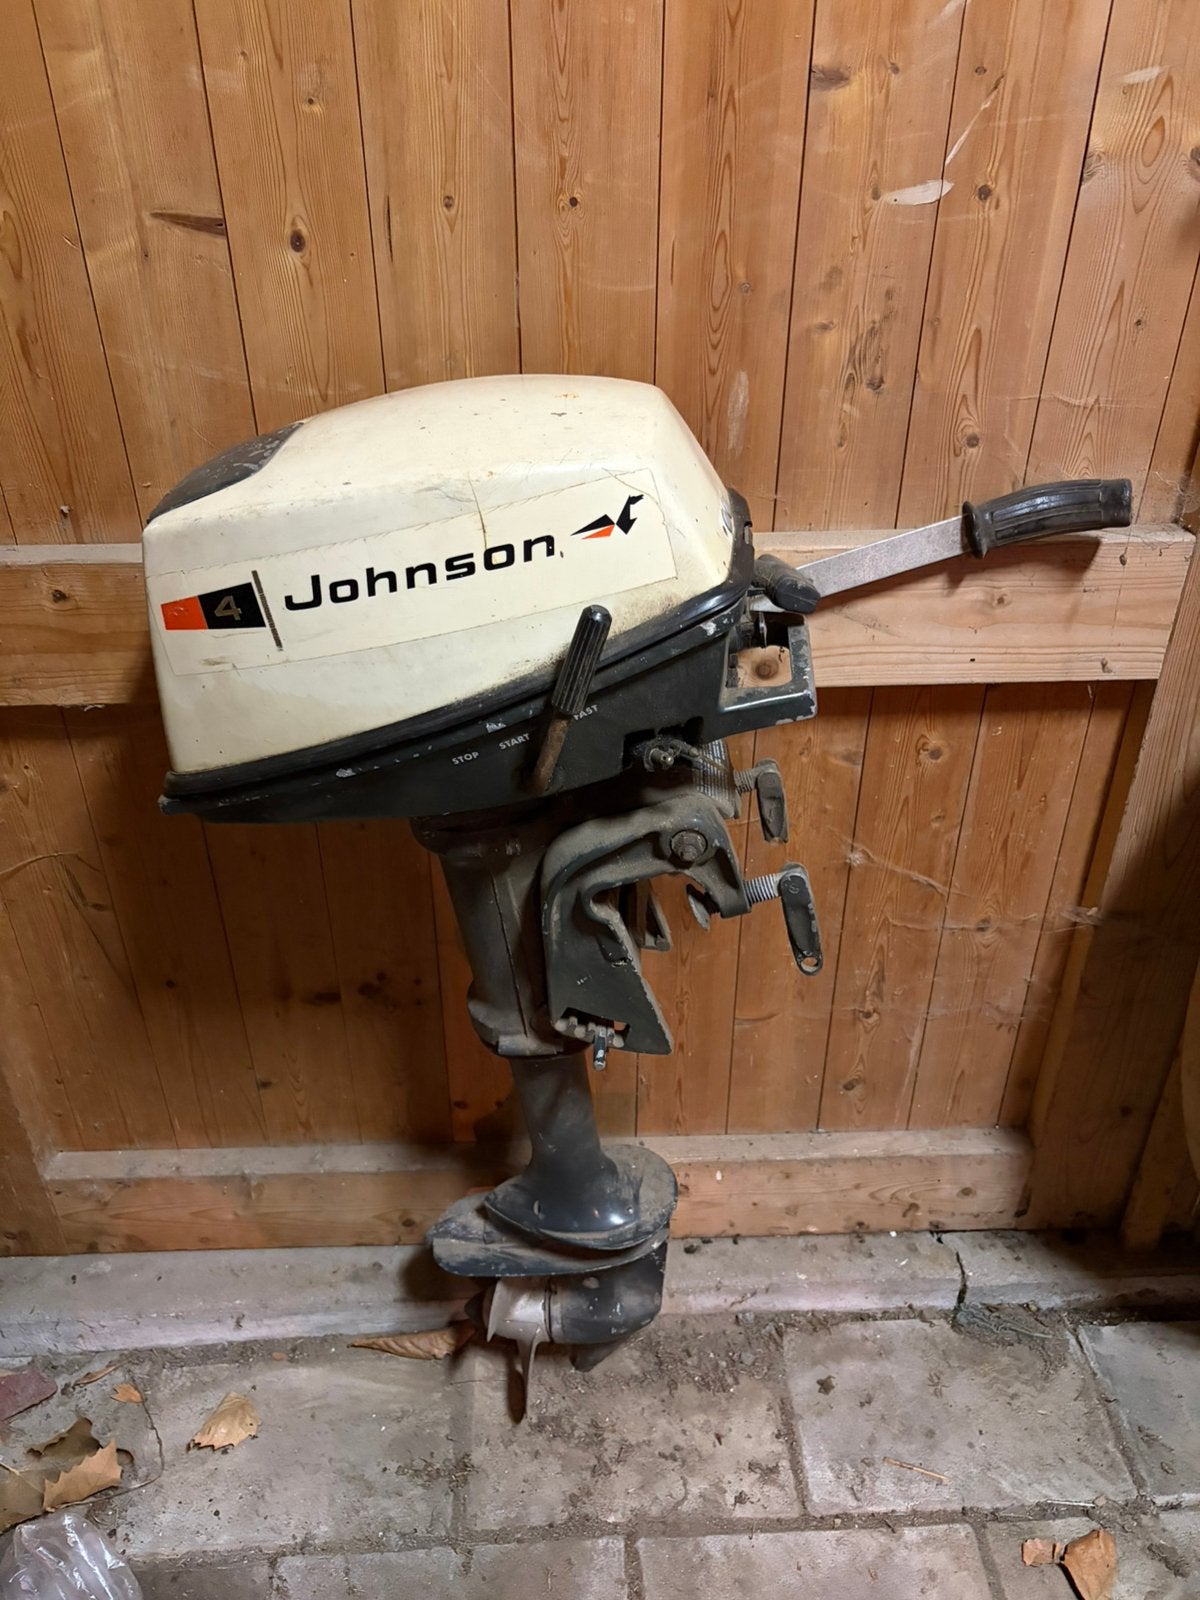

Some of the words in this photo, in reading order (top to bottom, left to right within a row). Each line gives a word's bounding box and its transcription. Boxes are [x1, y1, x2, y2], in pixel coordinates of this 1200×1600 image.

[284, 533, 555, 611] Johnson
[214, 595, 242, 621] 4
[451, 751, 480, 765] STOP
[499, 733, 531, 750] START
